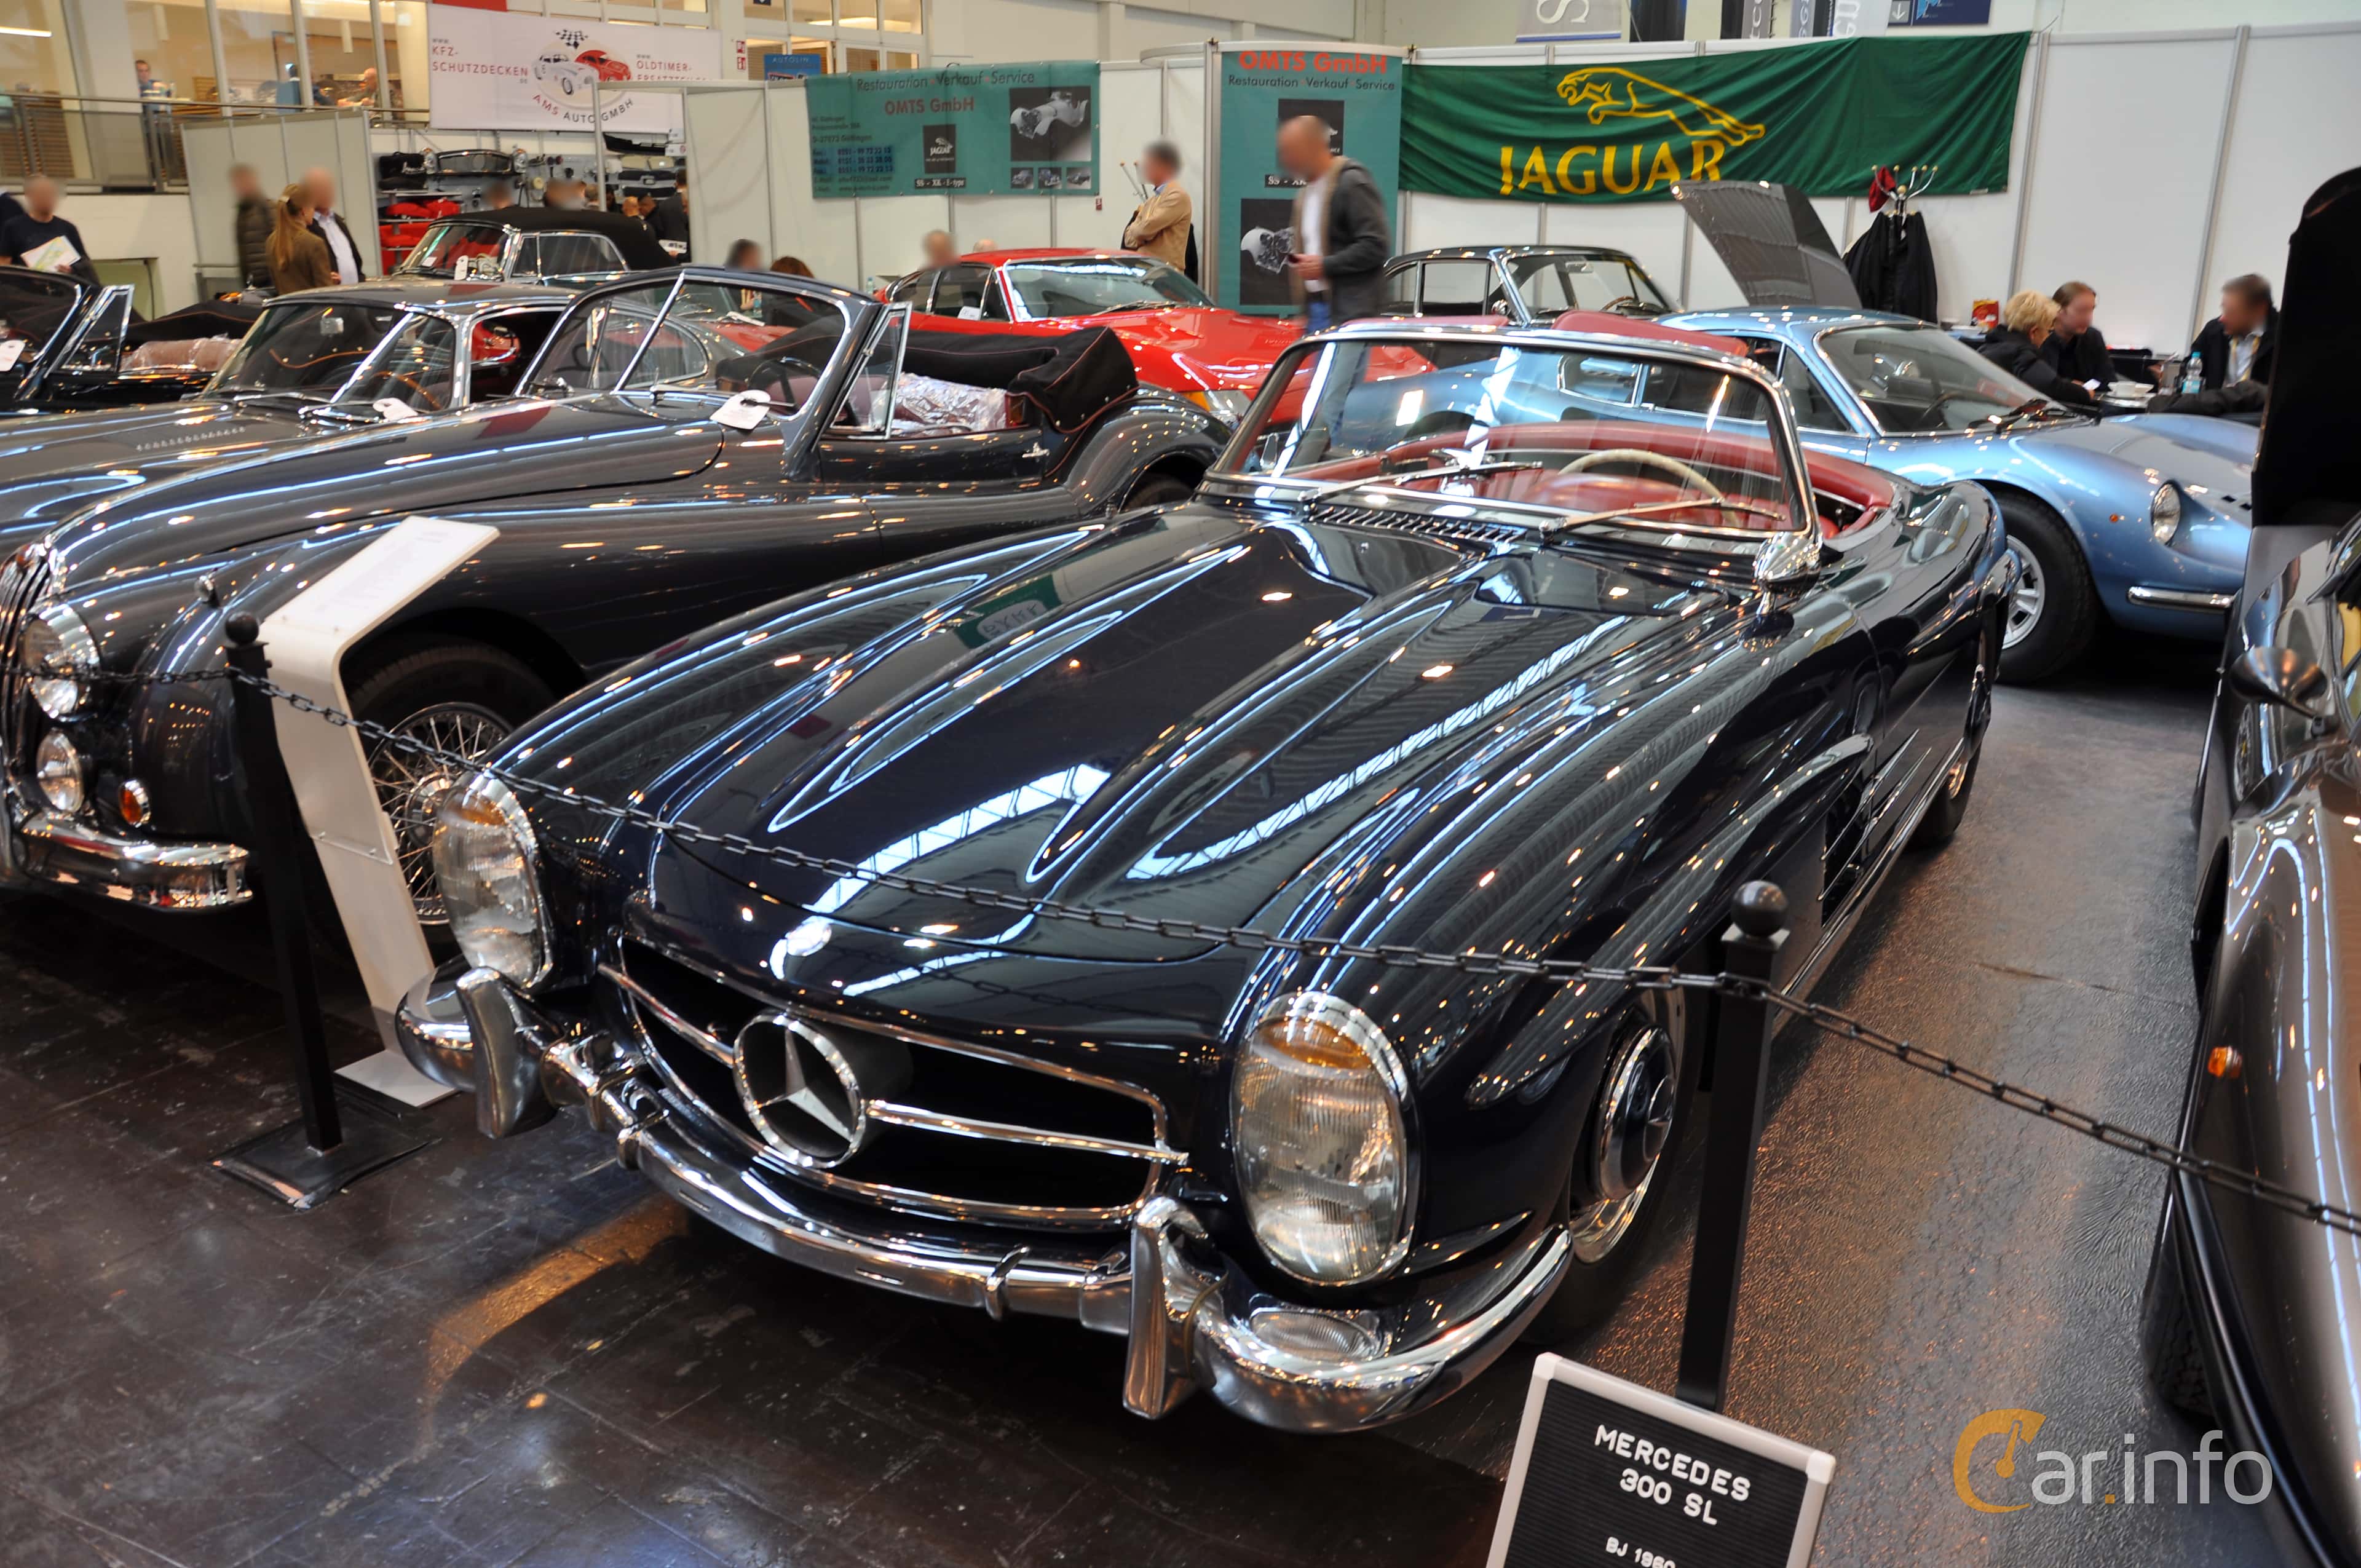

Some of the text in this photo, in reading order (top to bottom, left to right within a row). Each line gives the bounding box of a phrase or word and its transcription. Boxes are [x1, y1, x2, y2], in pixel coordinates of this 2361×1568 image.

[432, 46, 458, 57] KFZ-
[1238, 50, 1387, 74] OMTS GmbH
[432, 61, 528, 76] SCHUTZDECKEN
[636, 60, 692, 71] OLDTIMER-
[857, 71, 1035, 92] Restauration Verkauf Service
[1228, 74, 1396, 90] Restauration Verkauf Service
[532, 94, 633, 124] AMS AUTO GMBH
[884, 96, 975, 116] OMTS GmbH
[1499, 139, 1725, 196] JAGUAR
[1595, 1424, 1751, 1502] MERCEDES
[1619, 1468, 1718, 1526] 300 SL
[1605, 1536, 1629, 1557] BJ
